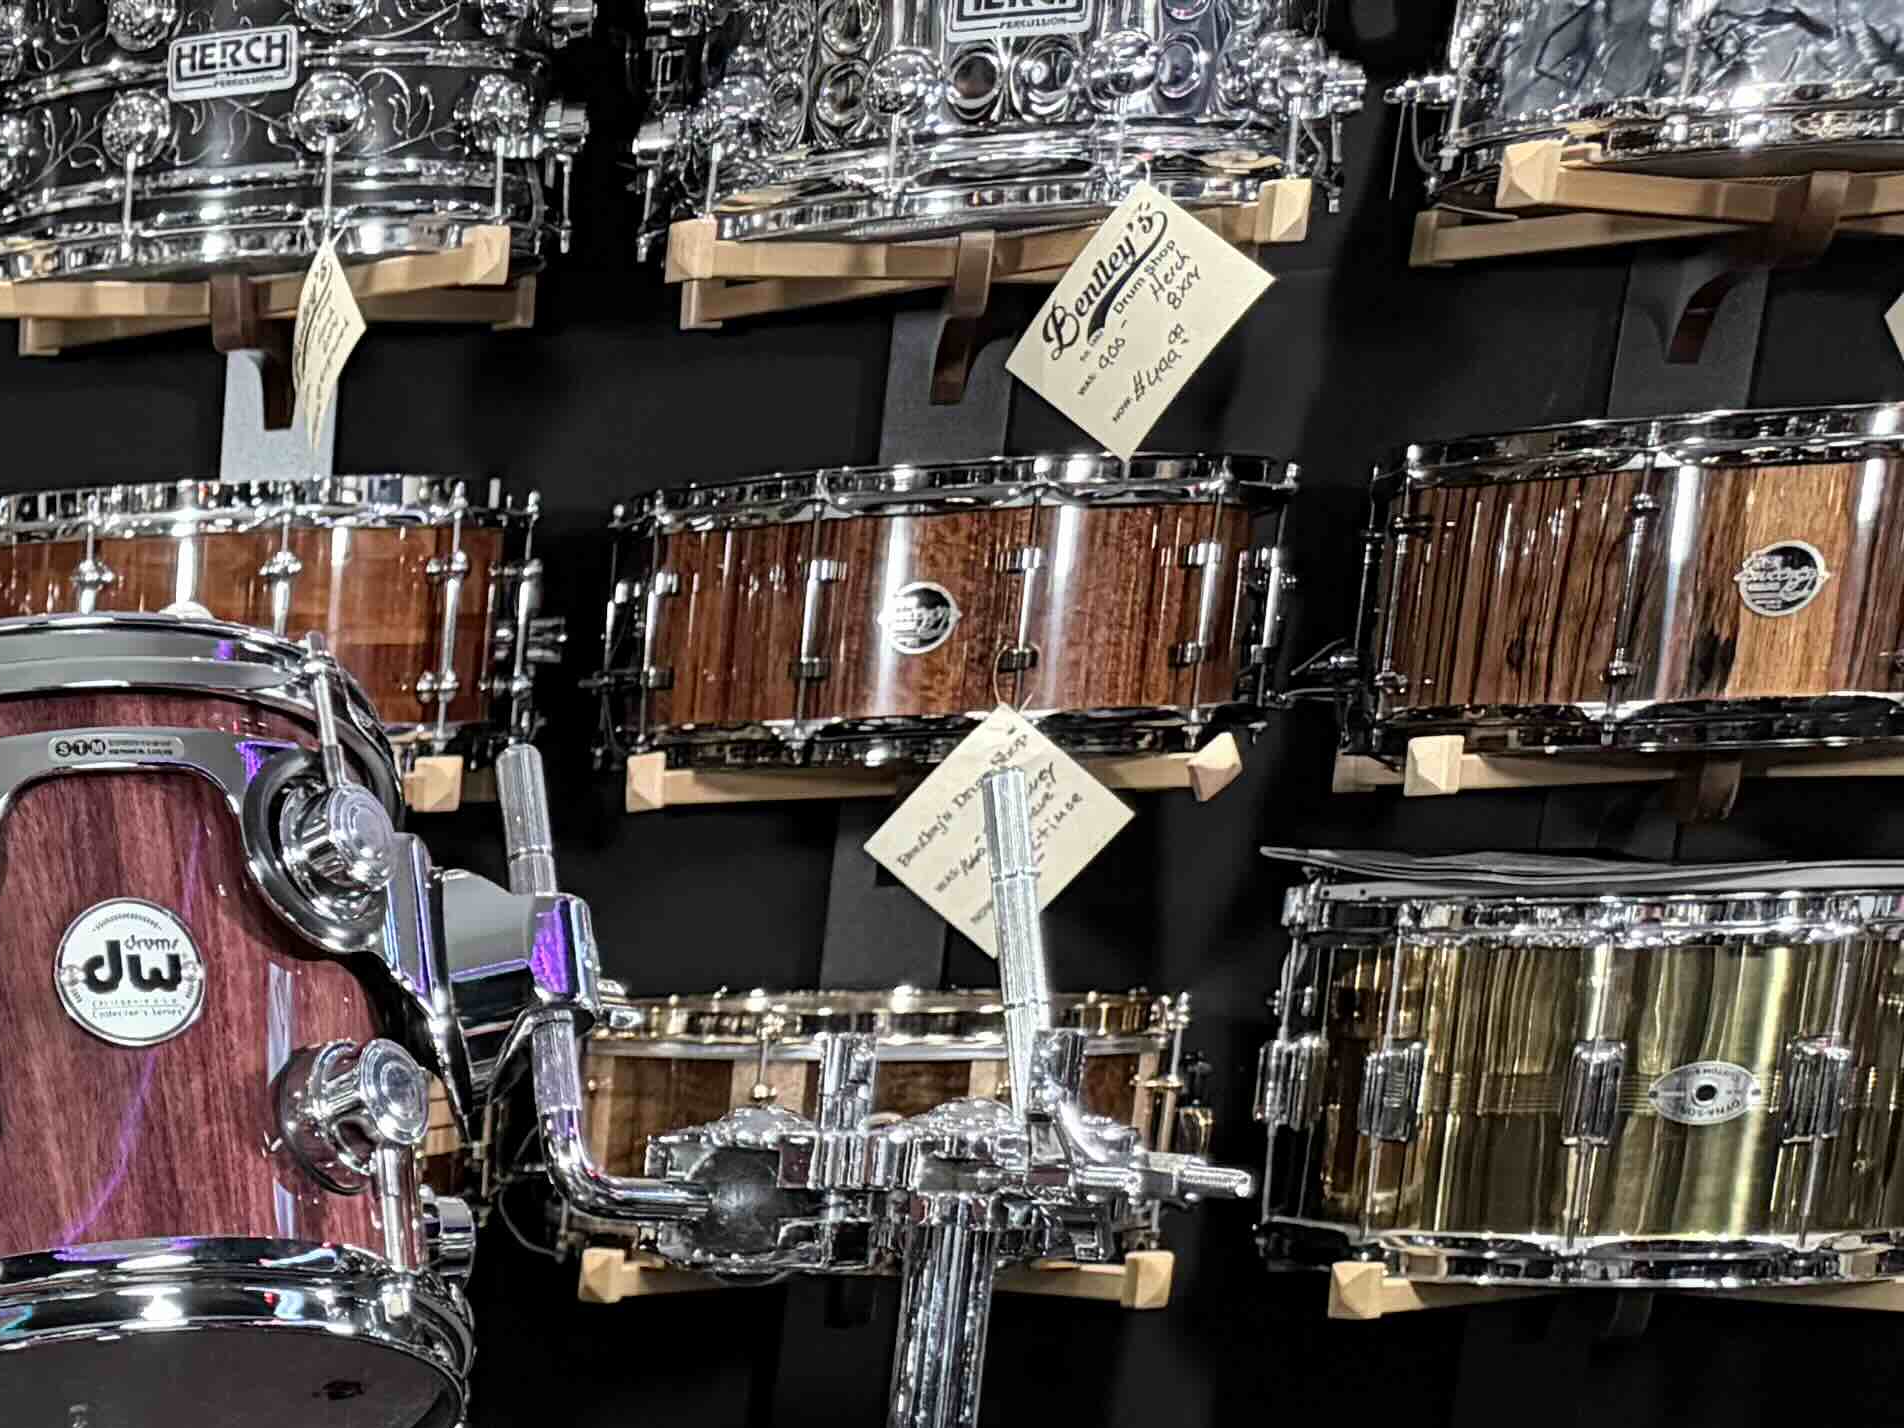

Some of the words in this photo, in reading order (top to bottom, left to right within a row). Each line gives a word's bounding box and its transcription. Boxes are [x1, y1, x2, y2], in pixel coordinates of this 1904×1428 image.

[176, 33, 288, 73] HERCH
[1042, 210, 1168, 361] Bentley's
[1113, 278, 1145, 315] Drum
[1144, 238, 1176, 273] Shop
[82, 940, 183, 994] dw
[124, 934, 179, 951] drums
